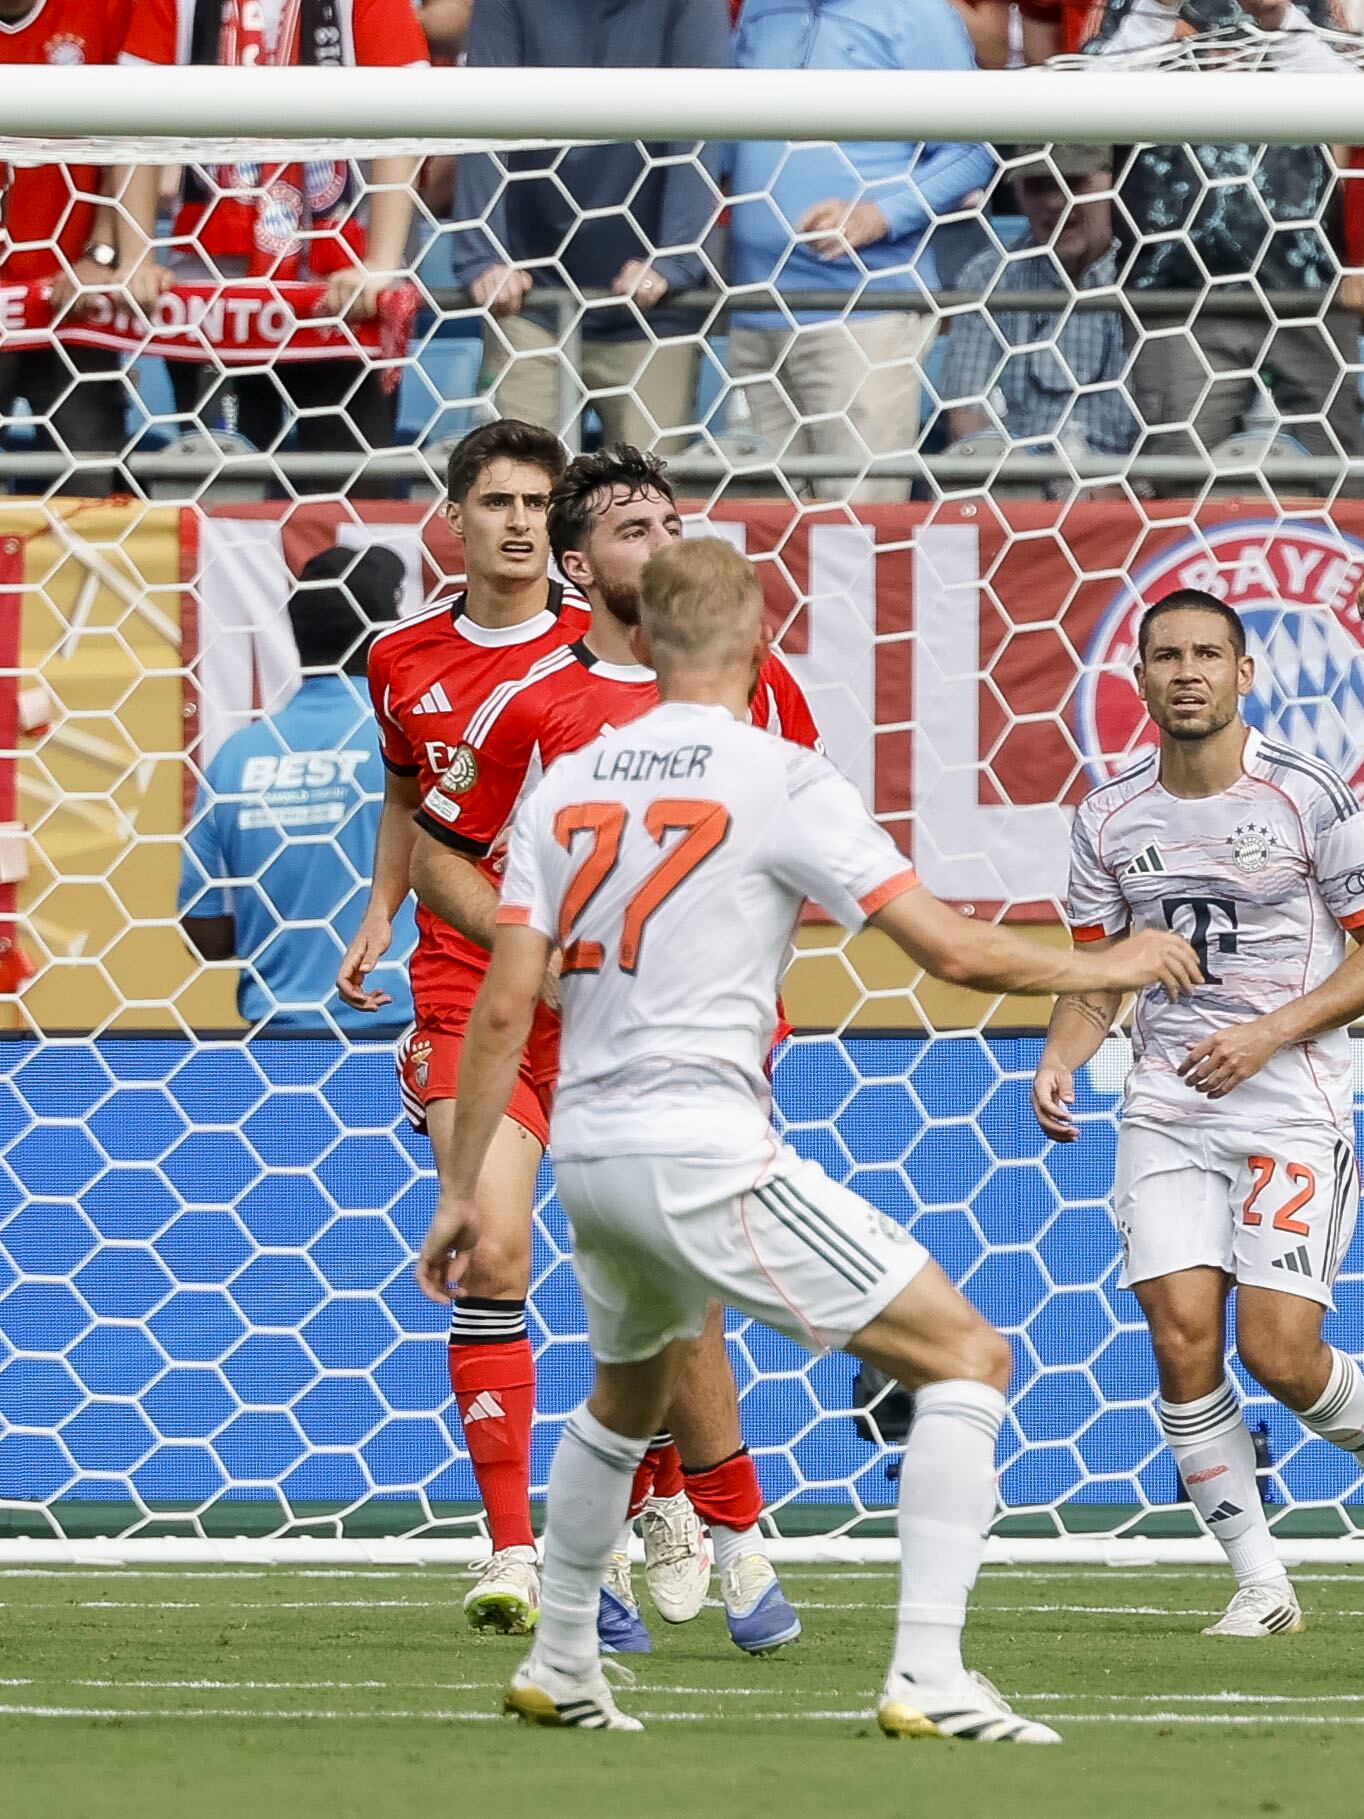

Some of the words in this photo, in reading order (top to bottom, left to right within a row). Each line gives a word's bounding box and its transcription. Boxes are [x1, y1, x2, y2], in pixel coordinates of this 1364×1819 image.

[240, 750, 371, 791] BEST
[592, 744, 714, 781] LAIMER
[553, 797, 733, 978] 27
[1242, 1155, 1316, 1238] 22
